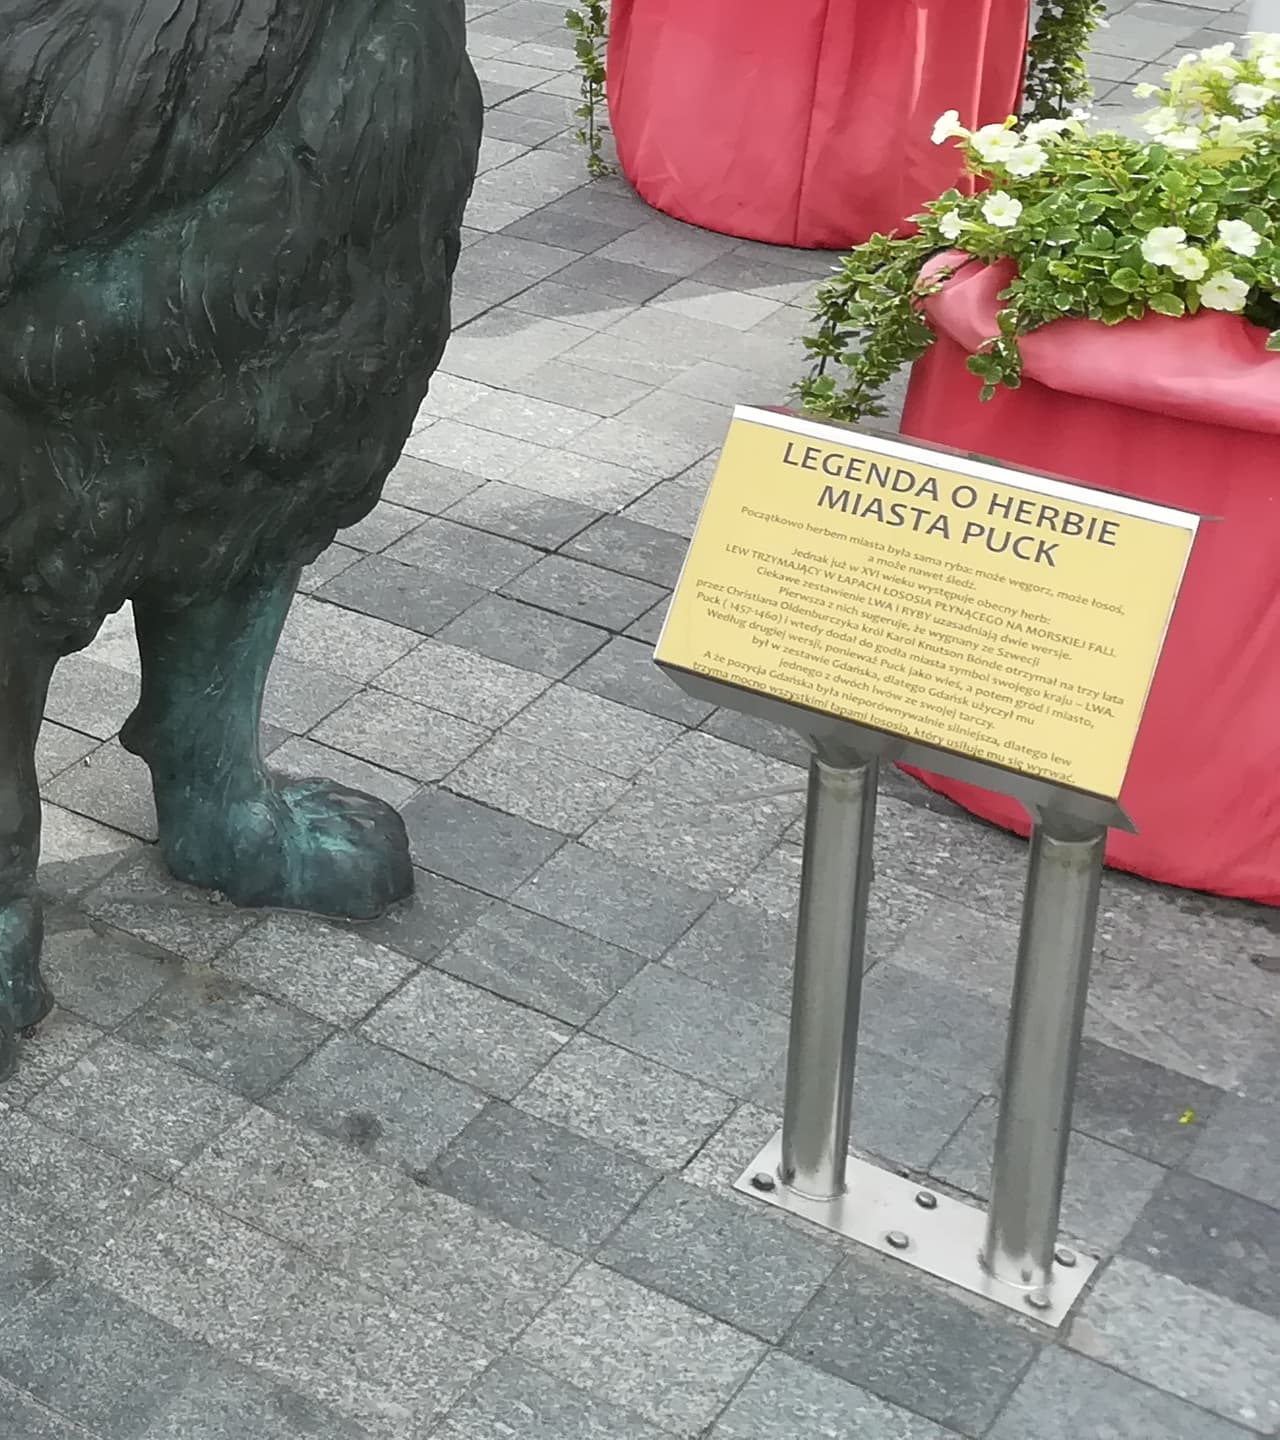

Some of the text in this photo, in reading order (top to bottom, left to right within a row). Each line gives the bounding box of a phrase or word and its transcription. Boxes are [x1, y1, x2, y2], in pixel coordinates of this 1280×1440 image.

[783, 442, 1119, 546] LEGENDA O HERBIE
[818, 485, 1059, 566] MIASTA PUCK
[725, 543, 750, 556] LEW
[1025, 625, 1086, 649] MORSKIEJ
[756, 566, 801, 586] Ciekawe
[802, 580, 866, 604] zestawienie
[867, 596, 893, 612] LWA
[901, 605, 933, 621] RYBY
[999, 633, 1029, 649] dwie
[791, 548, 829, 565] Jednak
[860, 566, 881, 579] XVI
[881, 573, 916, 588] wieku
[976, 599, 1019, 618] obecny
[805, 522, 848, 541] herbem
[849, 536, 886, 552] miasta
[886, 544, 912, 558] była
[912, 553, 943, 567] sama
[974, 569, 1007, 584] może
[1056, 591, 1089, 606] może
[876, 557, 907, 572] może
[908, 566, 944, 582] nawet
[695, 579, 725, 593] przez
[726, 585, 779, 608] Christiana
[861, 623, 885, 637] król
[885, 630, 916, 647] Karol
[917, 640, 964, 660] Knutson
[1004, 666, 1058, 687] otrzymał
[1076, 685, 1101, 700] trzy
[1101, 691, 1125, 705] lata
[696, 591, 721, 606] Puck
[790, 619, 825, 637] wtedy
[825, 628, 858, 644] dodał
[873, 643, 907, 659] godła
[908, 653, 947, 670] miasta
[948, 665, 991, 683] symbol
[991, 677, 1041, 697] swojego
[1042, 689, 1073, 706] kraju
[707, 607, 748, 629] Według
[748, 620, 787, 641] drugiej
[824, 644, 878, 665] ponieważ
[879, 658, 906, 673] Puck
[907, 666, 933, 681] jako
[974, 687, 1014, 705] potem
[1013, 699, 1045, 713] gród
[778, 586, 826, 607] Pierwsza
[835, 603, 859, 616] nich
[928, 629, 980, 651] wygnany
[995, 647, 1041, 668] Szwecji
[691, 661, 729, 681] trzyma
[730, 673, 767, 690] mocno
[768, 685, 829, 710] wszystkimi
[829, 701, 869, 722] łapami
[912, 726, 945, 745] który
[945, 738, 985, 757] usiłuje
[986, 751, 1006, 762] mu
[726, 658, 767, 676] pozycja
[815, 682, 840, 698] była
[1003, 740, 1048, 760] dlatego
[1050, 752, 1072, 767] lew
[751, 634, 770, 648] był
[782, 646, 830, 666] zestawie
[882, 674, 926, 694] dlatego
[971, 701, 1015, 720] użyczył
[1015, 714, 1035, 726] mu
[778, 657, 823, 678] jednego
[832, 674, 870, 692] dwóch
[871, 684, 903, 701] lwów
[919, 701, 957, 720] swojej
